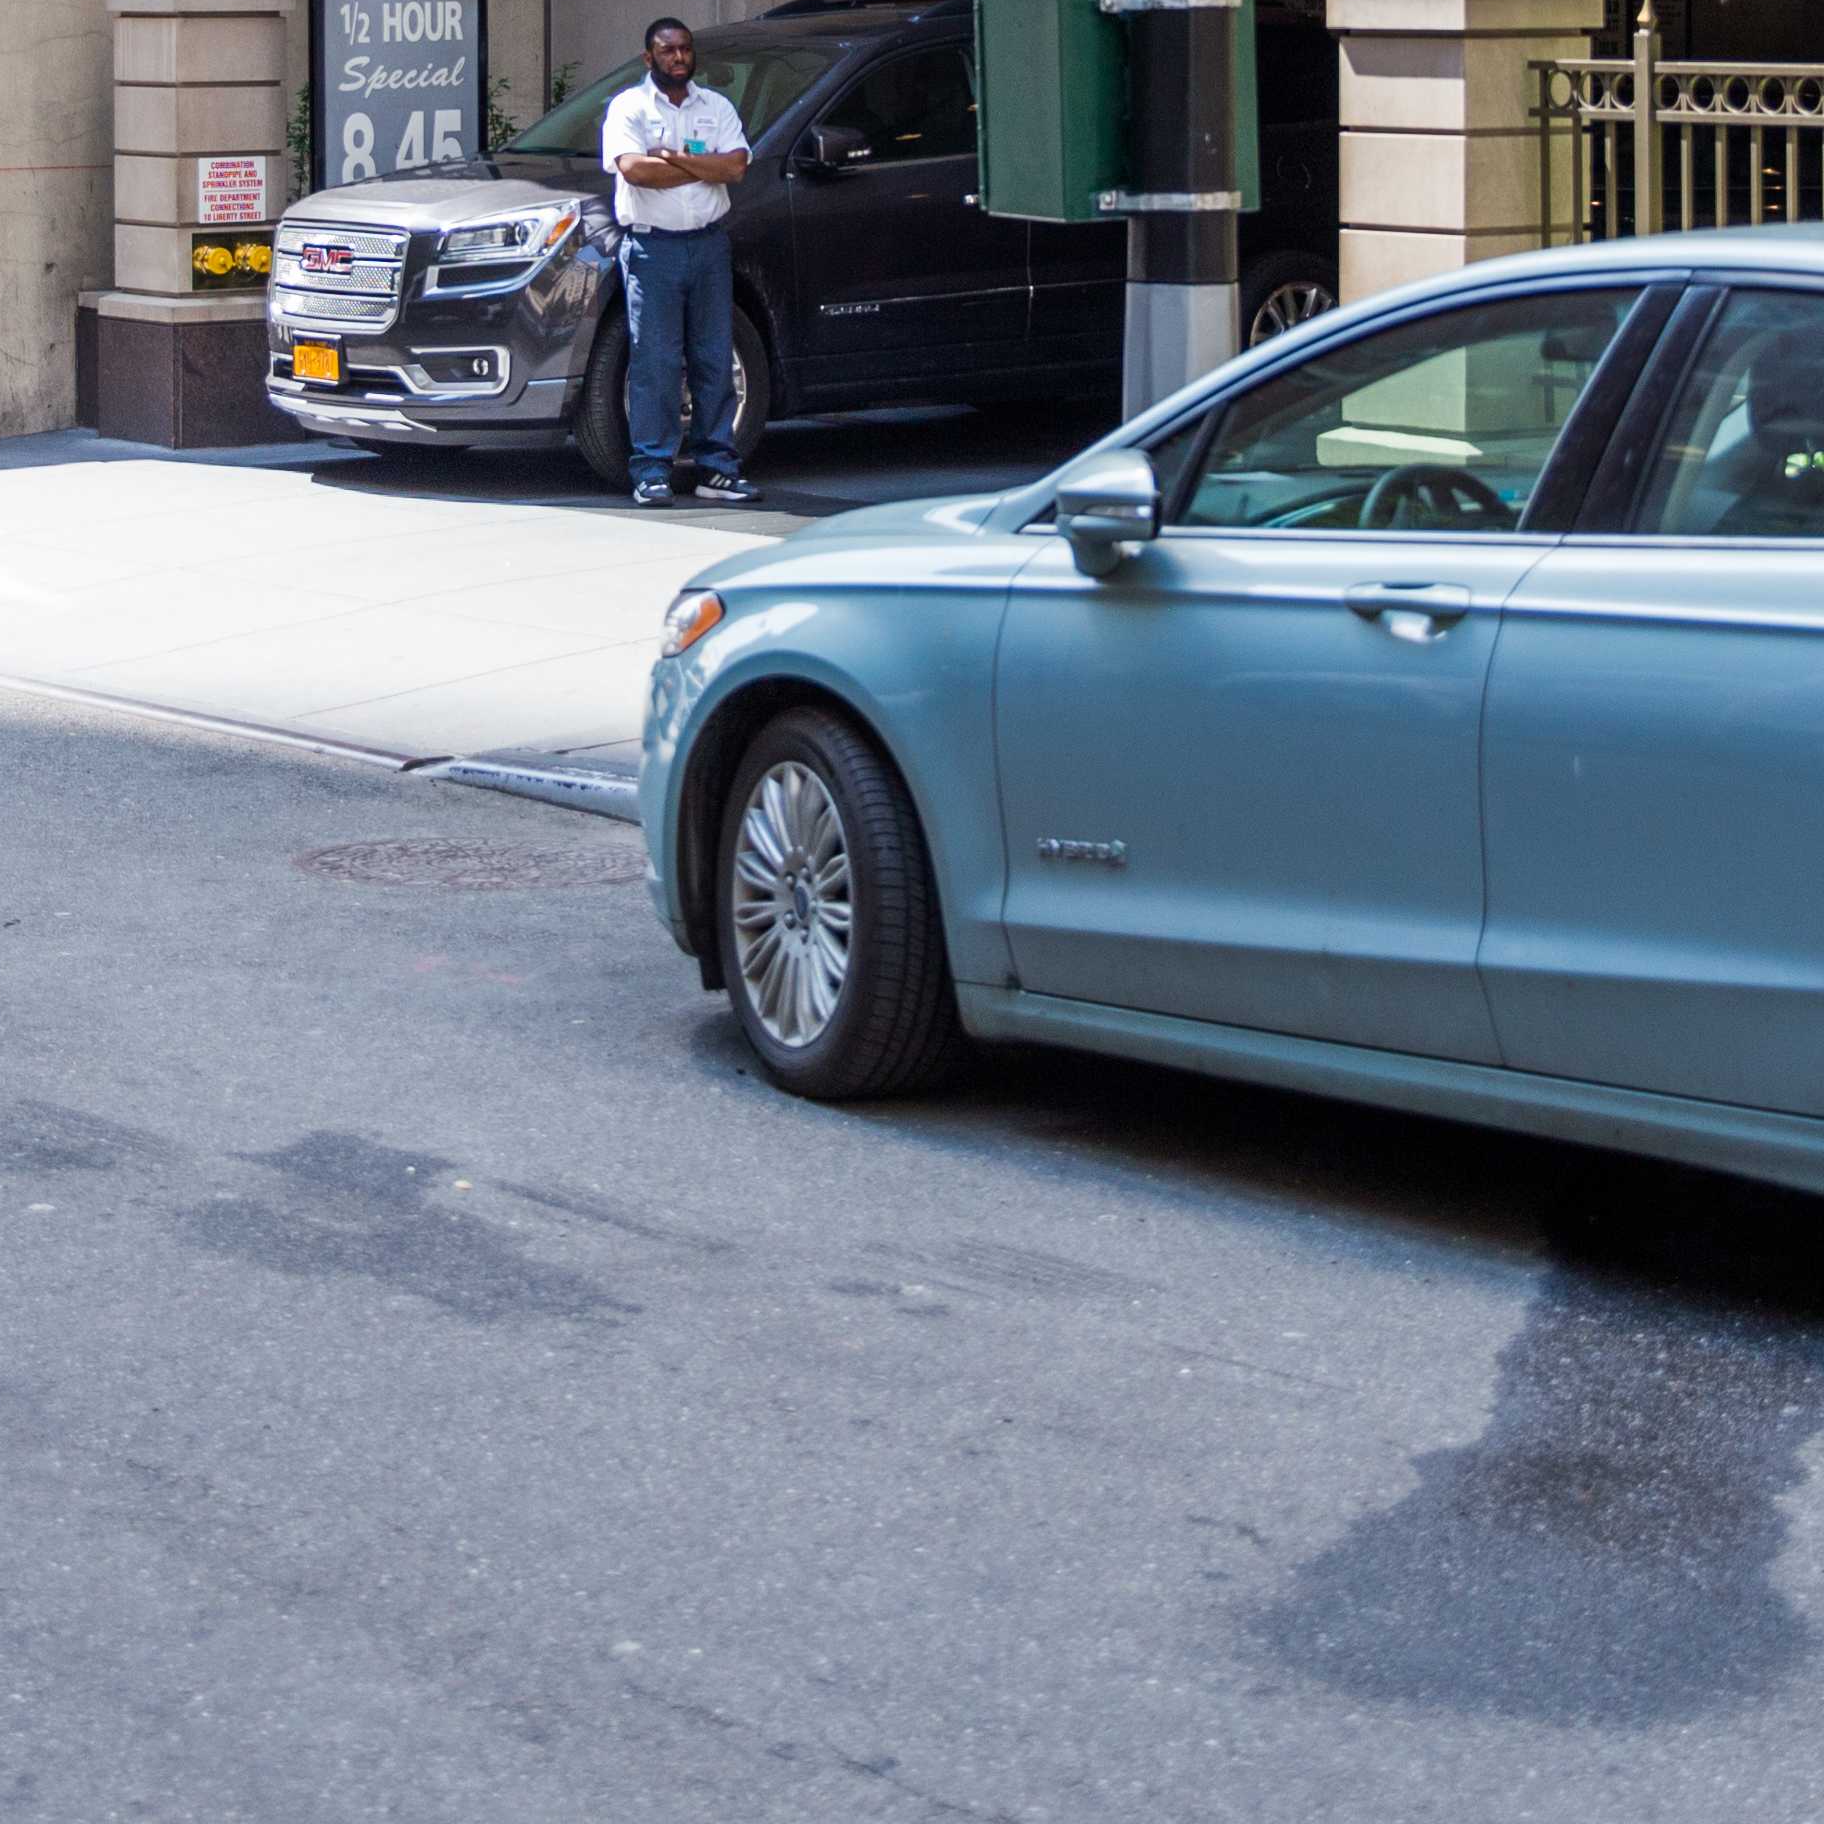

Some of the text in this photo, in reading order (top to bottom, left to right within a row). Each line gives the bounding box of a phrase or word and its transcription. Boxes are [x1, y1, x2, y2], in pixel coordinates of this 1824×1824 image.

[340, 0, 464, 46] 1/2 HOUR
[338, 56, 466, 99] Special
[210, 161, 255, 169] COMBINATION
[244, 170, 257, 178] AND
[203, 179, 263, 189] SPRINKLER SYSTEM
[204, 193, 261, 202] FIRE DEPARTMENT
[210, 203, 255, 212] CONNECTIONS
[213, 212, 238, 222] LIBERTY
[239, 211, 262, 221] STREET
[301, 246, 353, 273] GMC
